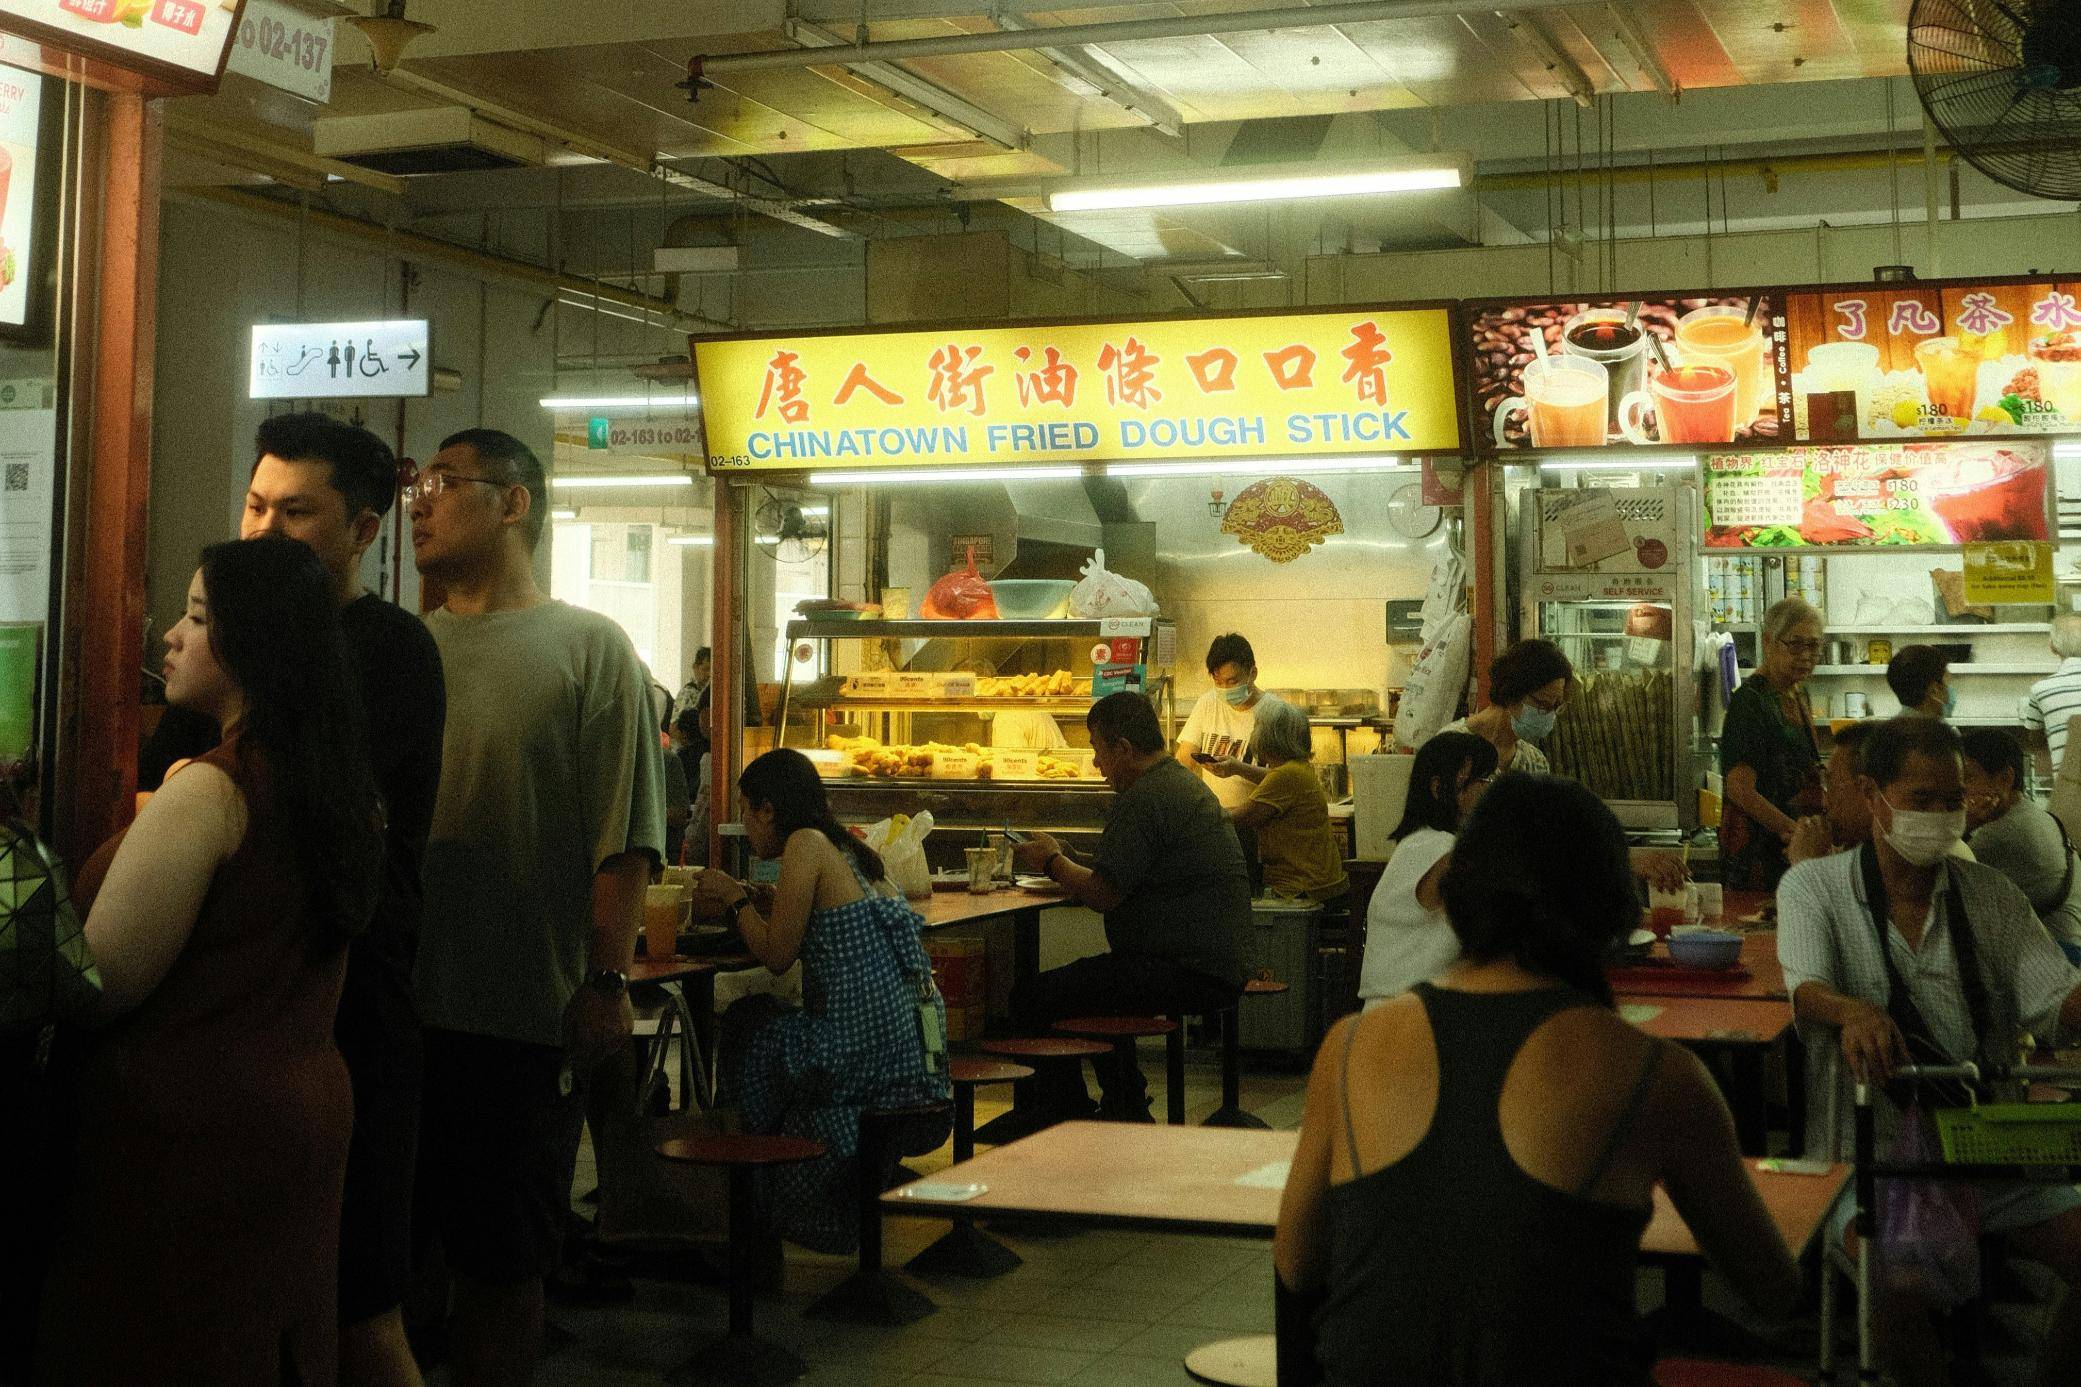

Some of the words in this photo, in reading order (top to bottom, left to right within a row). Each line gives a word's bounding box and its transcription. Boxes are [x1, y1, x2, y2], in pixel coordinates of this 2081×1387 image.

[259, 16, 328, 73] 02-137
[1834, 291, 2081, 338] 了凡茶水
[754, 321, 1393, 425] 唐人街油條口口香
[611, 429, 655, 446] 02-163
[657, 430, 673, 444] to
[747, 425, 969, 460] CHINATOWN
[986, 422, 1100, 452] FRIED
[1119, 416, 1266, 449] DOUGH
[1286, 410, 1413, 443] STICK
[711, 455, 751, 467] 02-163
[1814, 449, 1870, 471] 洛神花
[1602, 587, 1624, 596] SELF
[1626, 587, 1663, 596] SERVICE
